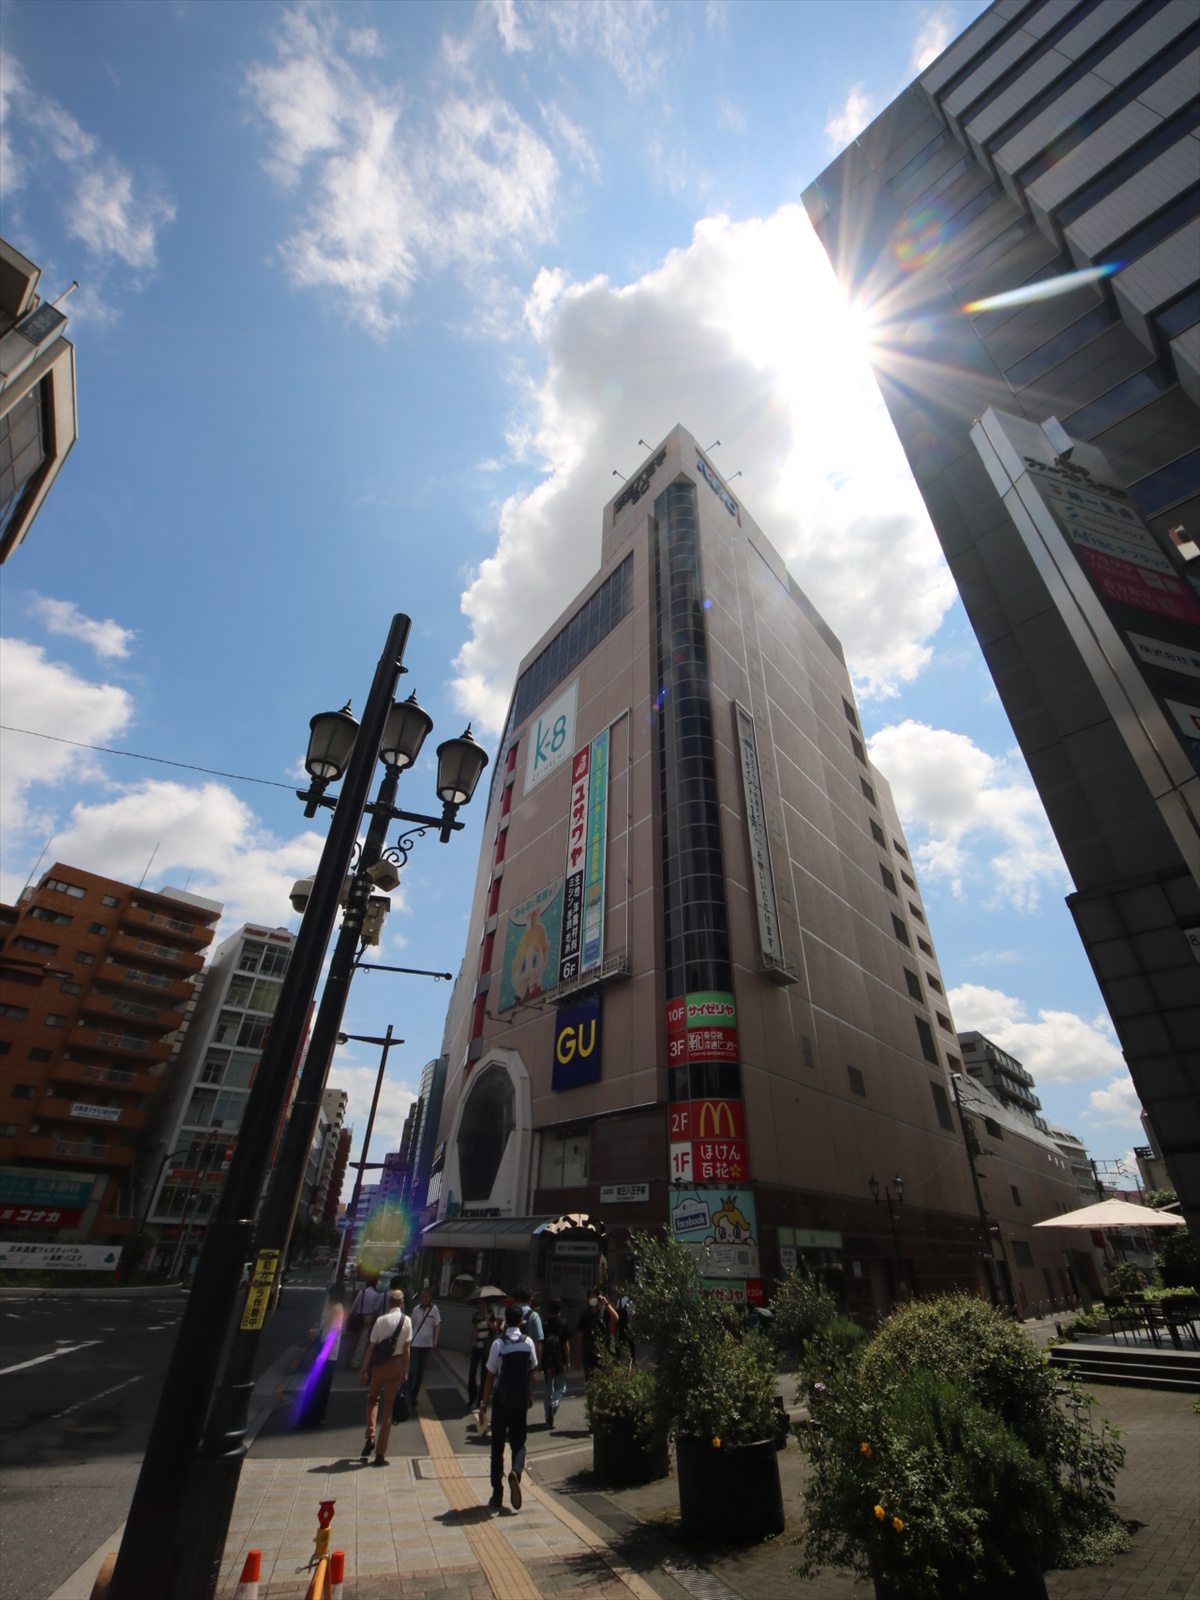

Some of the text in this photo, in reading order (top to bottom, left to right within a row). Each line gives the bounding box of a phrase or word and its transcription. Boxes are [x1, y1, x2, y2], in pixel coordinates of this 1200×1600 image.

[1073, 528, 1170, 569] Aflac アフラック
[570, 783, 585, 867] ユザワヤ
[562, 962, 576, 979] 6F
[668, 1002, 734, 1022] 10F サイゼリヤ
[556, 1019, 596, 1064] GU
[670, 1039, 685, 1057] 3F
[688, 1032, 703, 1051] 靴
[672, 1112, 688, 1132] 2F
[701, 1145, 740, 1160] ほけん
[673, 1152, 690, 1173] 1F
[702, 1162, 729, 1178] 百花
[616, 1185, 646, 1196] 京王八王子駅
[15, 1209, 62, 1223] コナカ
[676, 1215, 706, 1229] facebook
[249, 1252, 272, 1327] 犯カラ作動中
